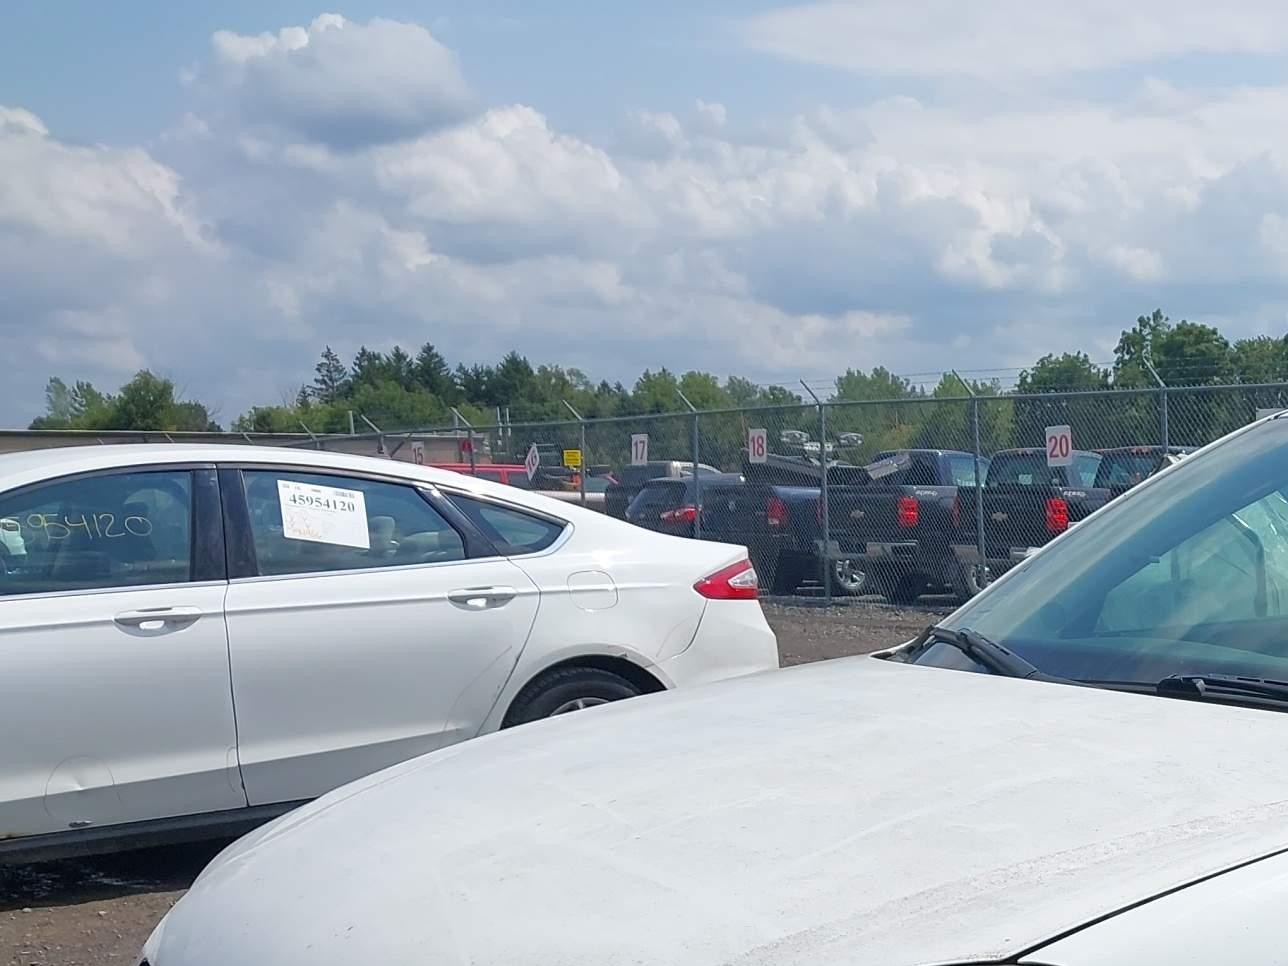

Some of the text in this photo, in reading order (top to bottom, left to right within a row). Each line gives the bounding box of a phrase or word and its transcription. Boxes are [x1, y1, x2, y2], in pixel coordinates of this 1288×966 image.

[633, 440, 646, 461] 17
[751, 435, 765, 457] 18
[1048, 434, 1070, 458] 20
[289, 493, 355, 513] 45954120
